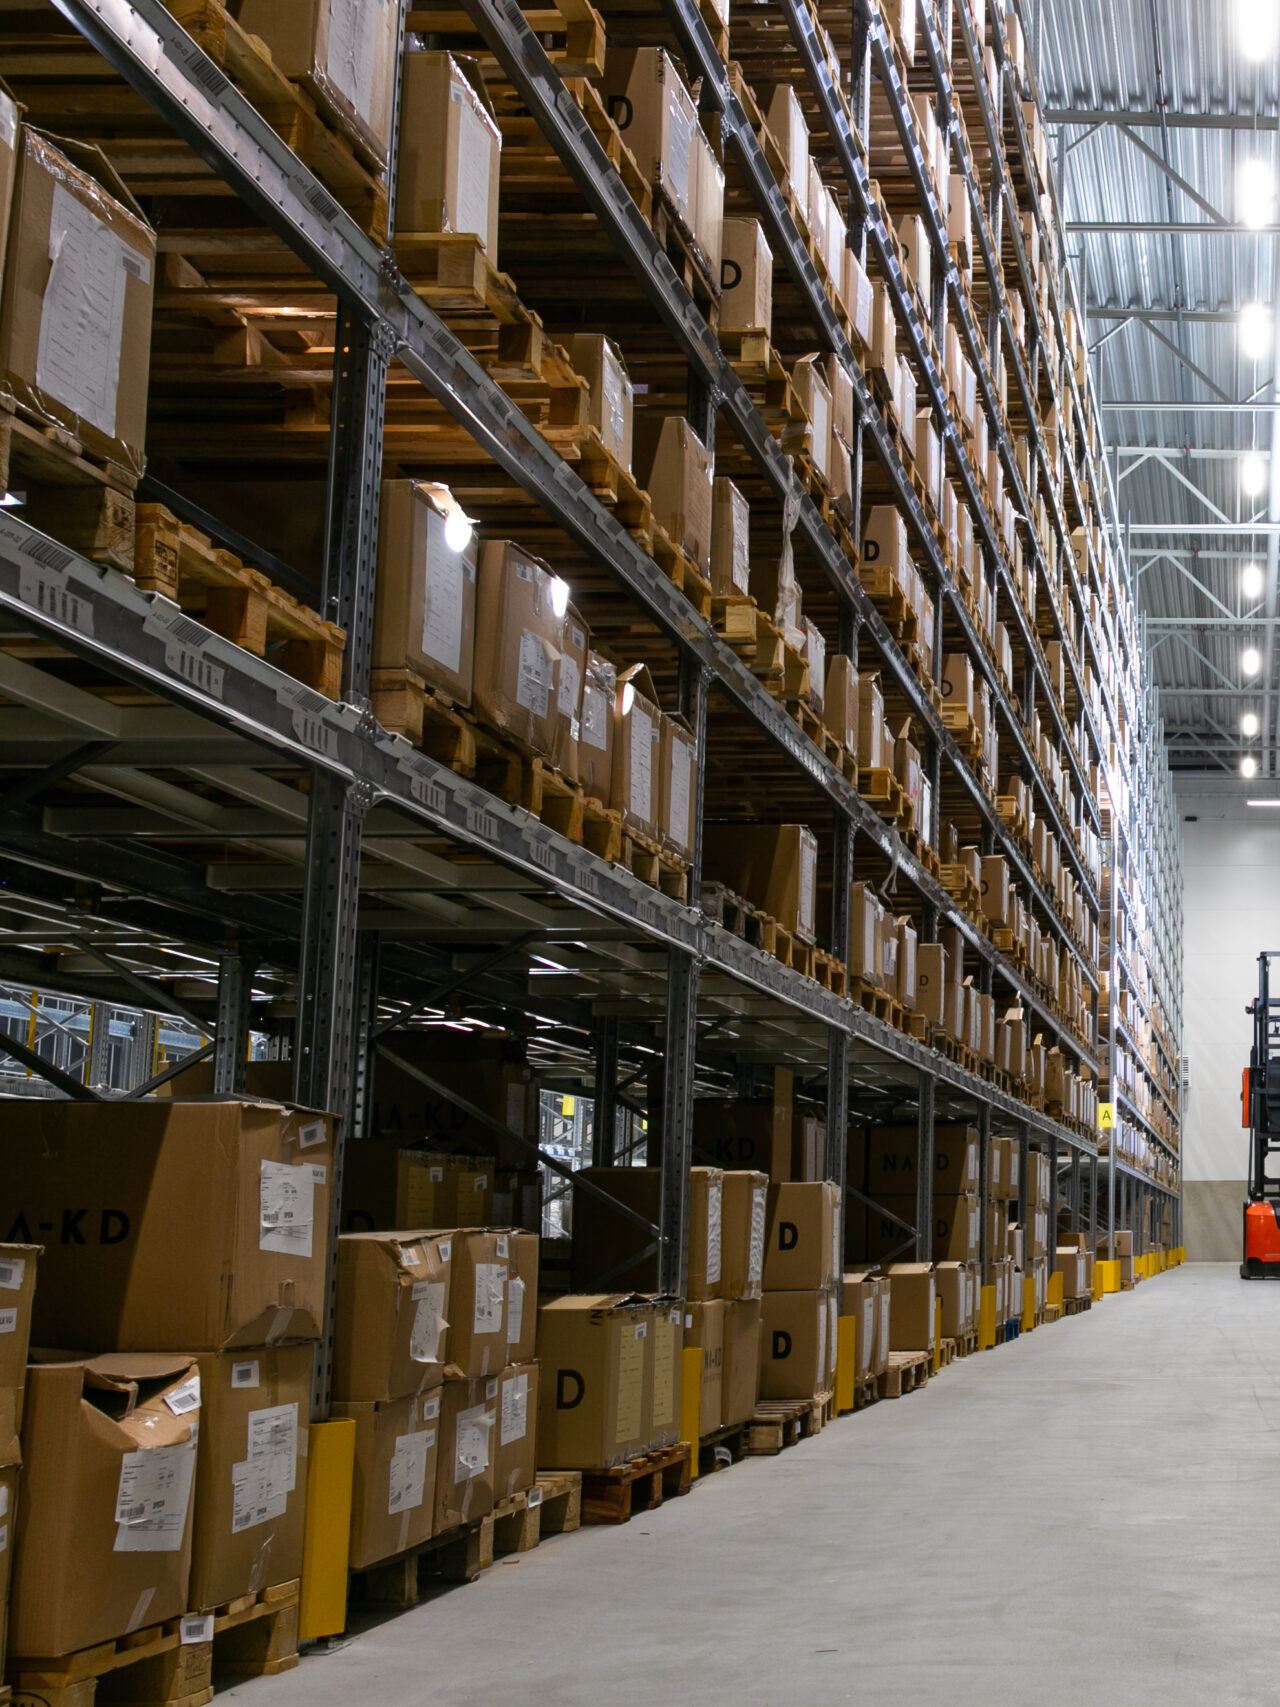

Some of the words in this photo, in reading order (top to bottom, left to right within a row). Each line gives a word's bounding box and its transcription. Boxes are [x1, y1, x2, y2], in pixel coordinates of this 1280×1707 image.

[864, 540, 880, 562] D
[919, 975, 929, 986] D
[1102, 1110, 1111, 1121] A
[779, 1222, 798, 1251] D
[772, 1330, 792, 1359] D
[556, 1369, 585, 1410] D
